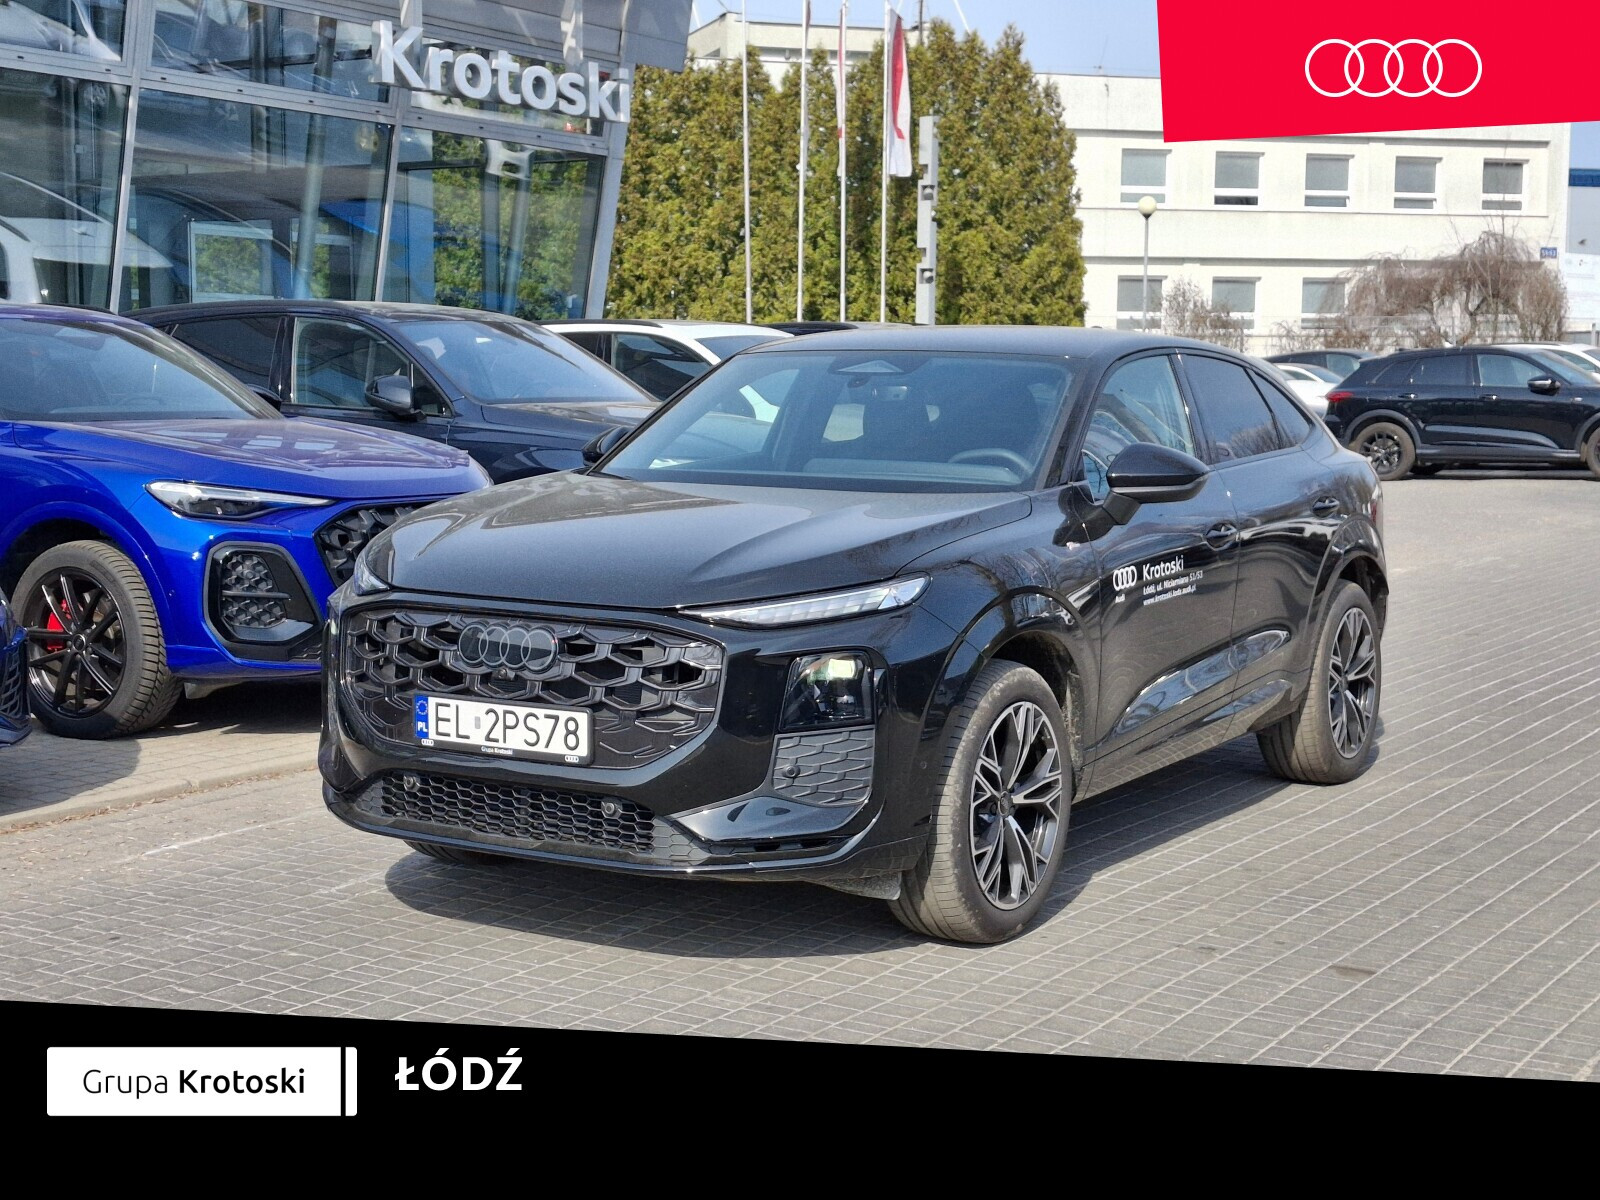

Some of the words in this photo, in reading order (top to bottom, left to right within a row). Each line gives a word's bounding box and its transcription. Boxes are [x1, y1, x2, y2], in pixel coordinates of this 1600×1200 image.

[370, 20, 630, 123] Krotoski
[1143, 555, 1184, 581] Krotoski
[417, 721, 428, 732] PL
[435, 701, 470, 740] EL
[484, 707, 580, 751] 2PS78
